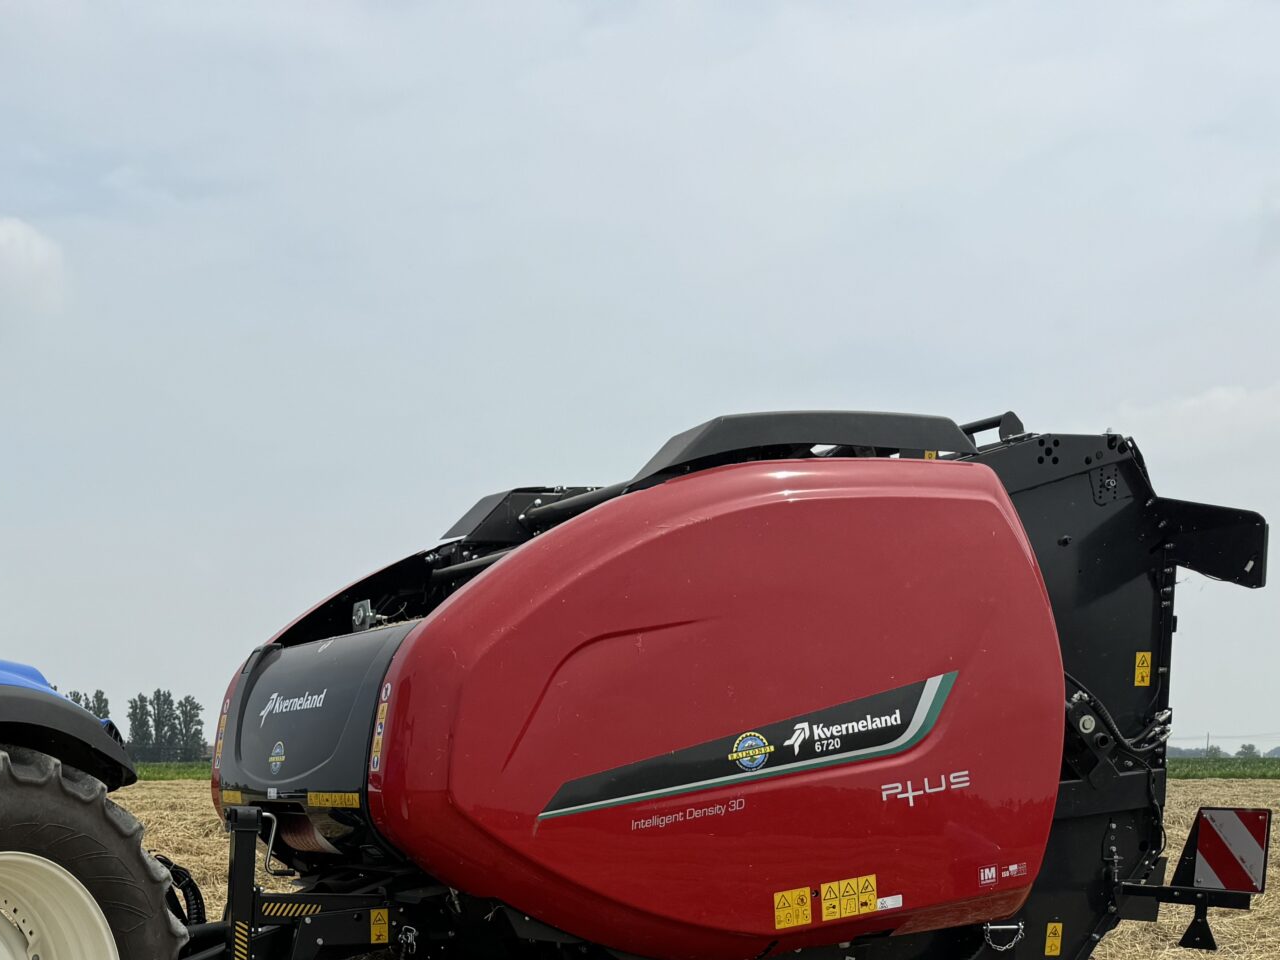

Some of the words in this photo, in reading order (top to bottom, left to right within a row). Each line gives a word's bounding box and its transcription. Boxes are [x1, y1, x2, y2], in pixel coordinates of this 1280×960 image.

[273, 688, 327, 714] Kverneland
[812, 709, 902, 741] Kverneland
[814, 737, 841, 753] 6720
[631, 812, 684, 831] Intelligent
[686, 804, 726, 820] Density
[728, 798, 745, 812] 3D
